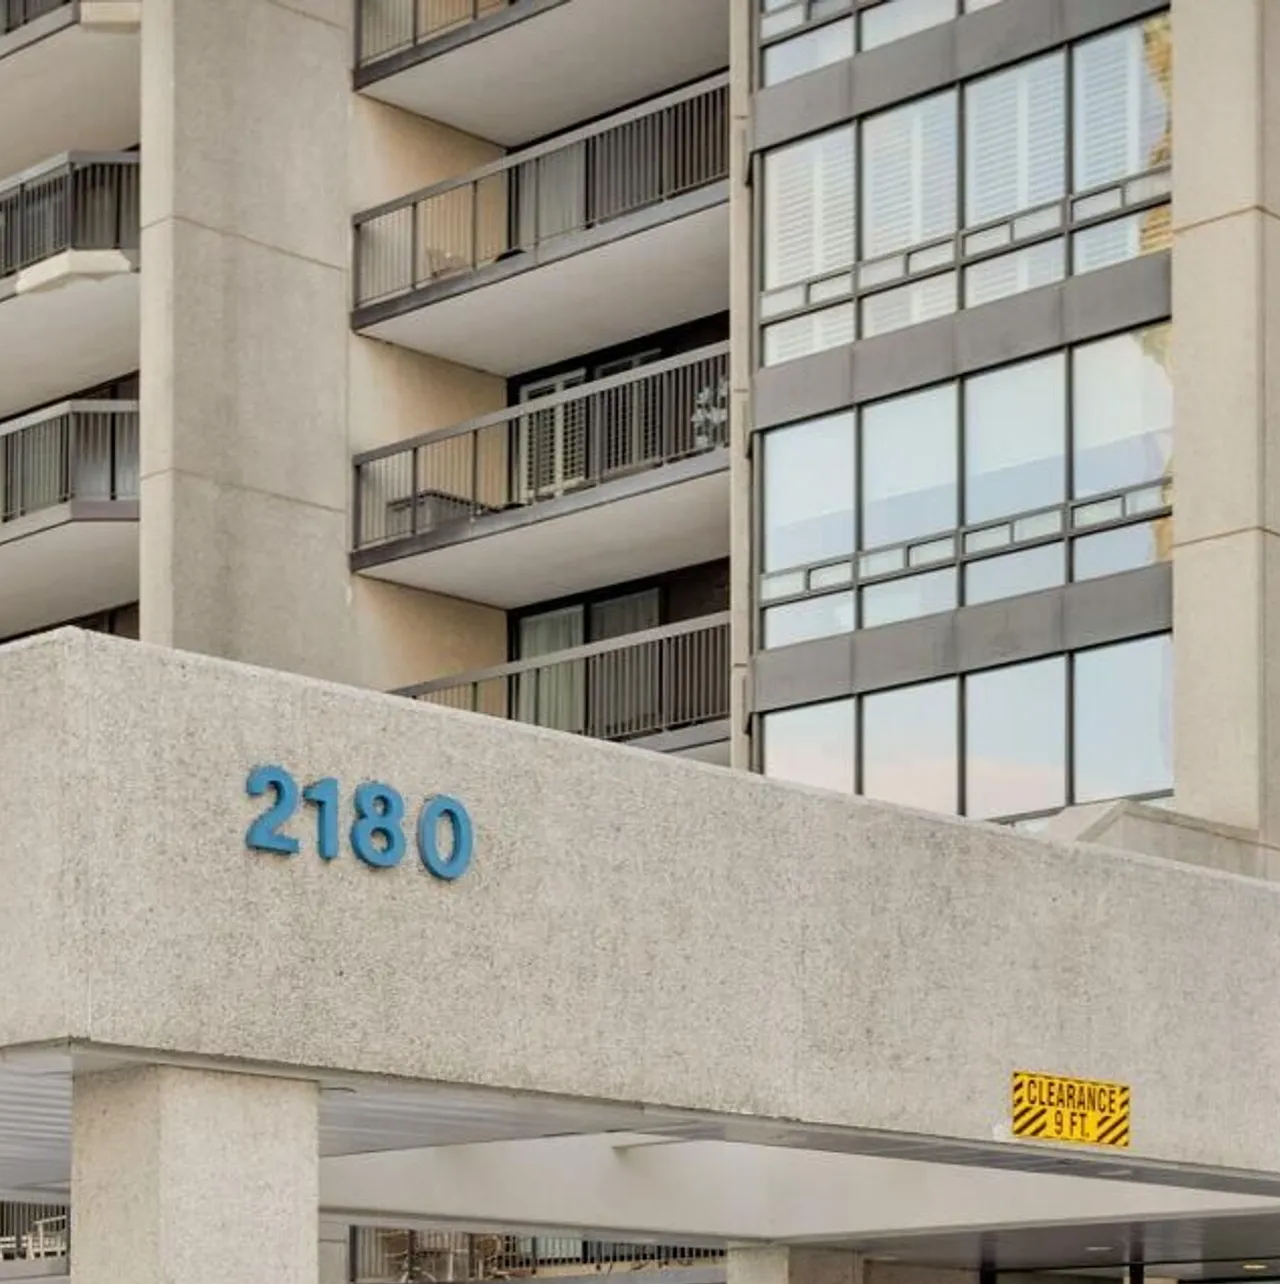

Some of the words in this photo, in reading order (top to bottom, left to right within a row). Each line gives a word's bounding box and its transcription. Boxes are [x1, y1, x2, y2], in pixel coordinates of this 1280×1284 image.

[245, 763, 475, 881] 2180
[1027, 1079, 1116, 1113] CLEARANCE
[1054, 1110, 1063, 1135] 9
[1069, 1111, 1090, 1138] FT.
